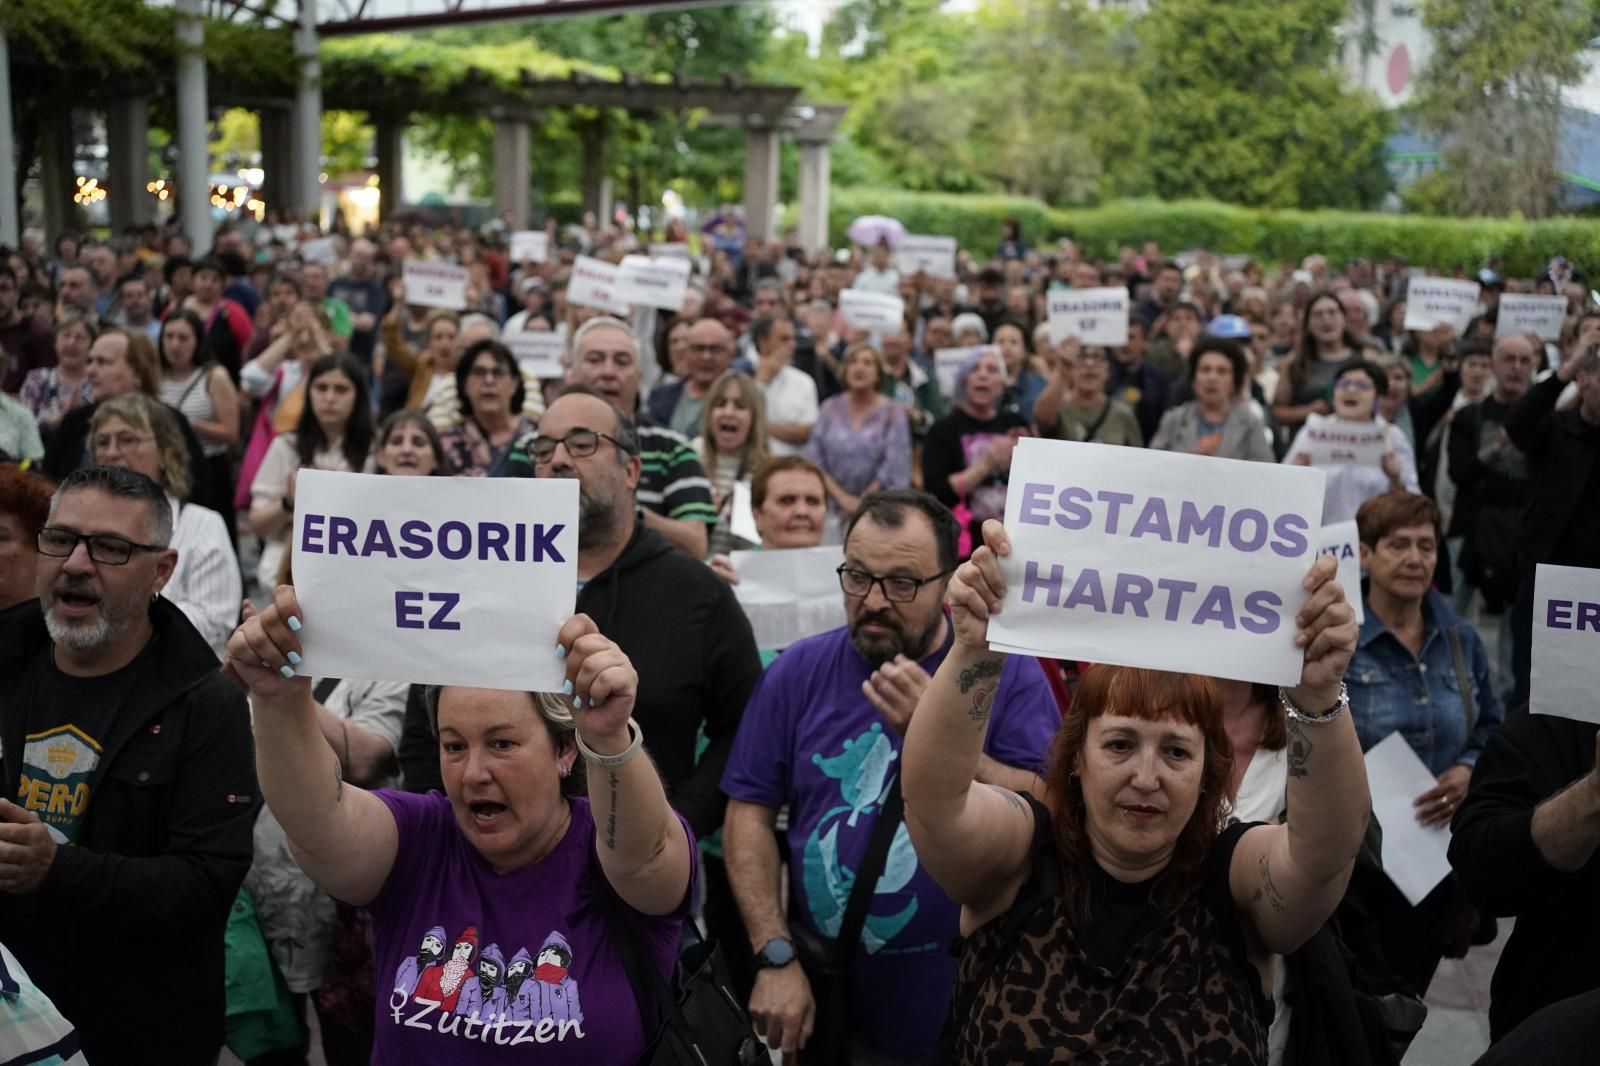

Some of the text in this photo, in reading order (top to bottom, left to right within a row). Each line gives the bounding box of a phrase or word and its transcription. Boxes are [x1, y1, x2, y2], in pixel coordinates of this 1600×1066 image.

[301, 513, 566, 563] ERASORIK
[1018, 482, 1309, 558] ESTAMOS
[394, 591, 461, 631] EZ
[1021, 560, 1283, 635] HARTAS
[1546, 599, 1600, 633] ER
[403, 996, 585, 1046] Zutitzen
